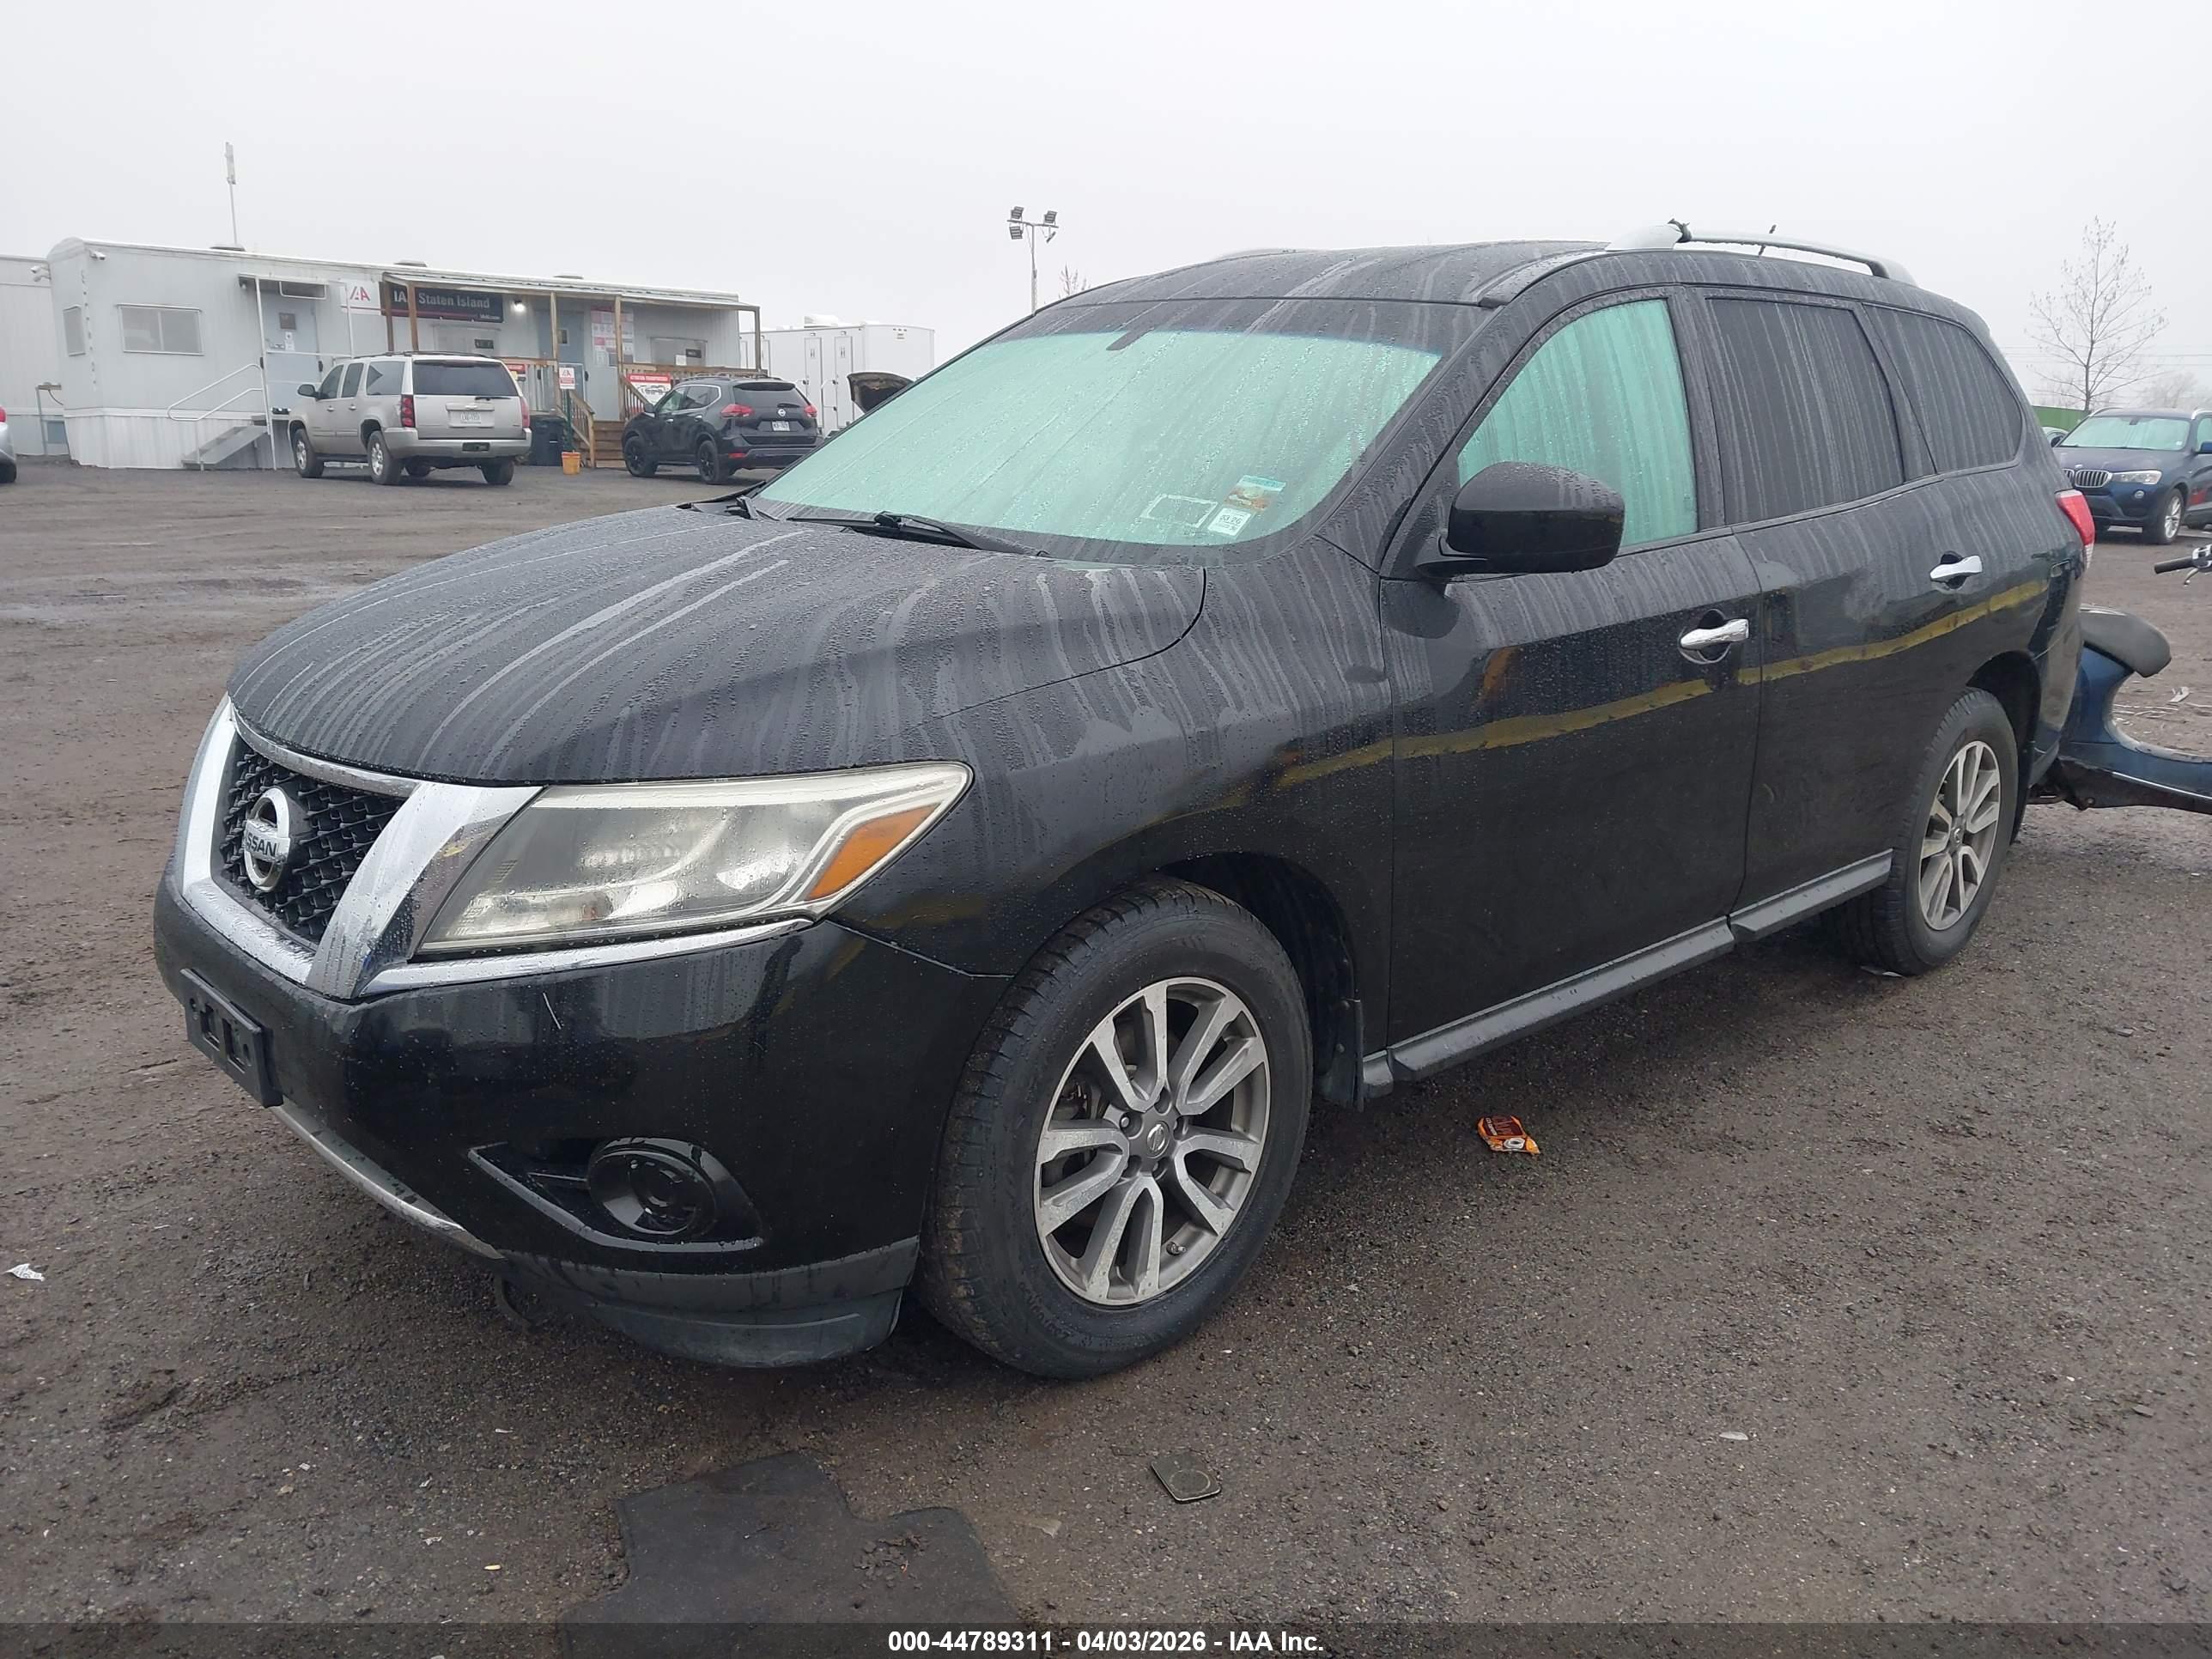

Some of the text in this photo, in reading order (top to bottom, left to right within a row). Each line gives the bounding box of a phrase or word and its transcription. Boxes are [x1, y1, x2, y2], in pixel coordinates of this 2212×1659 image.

[418, 293, 454, 307] Staten
[457, 295, 490, 308] Island
[243, 831, 277, 857] SSAN
